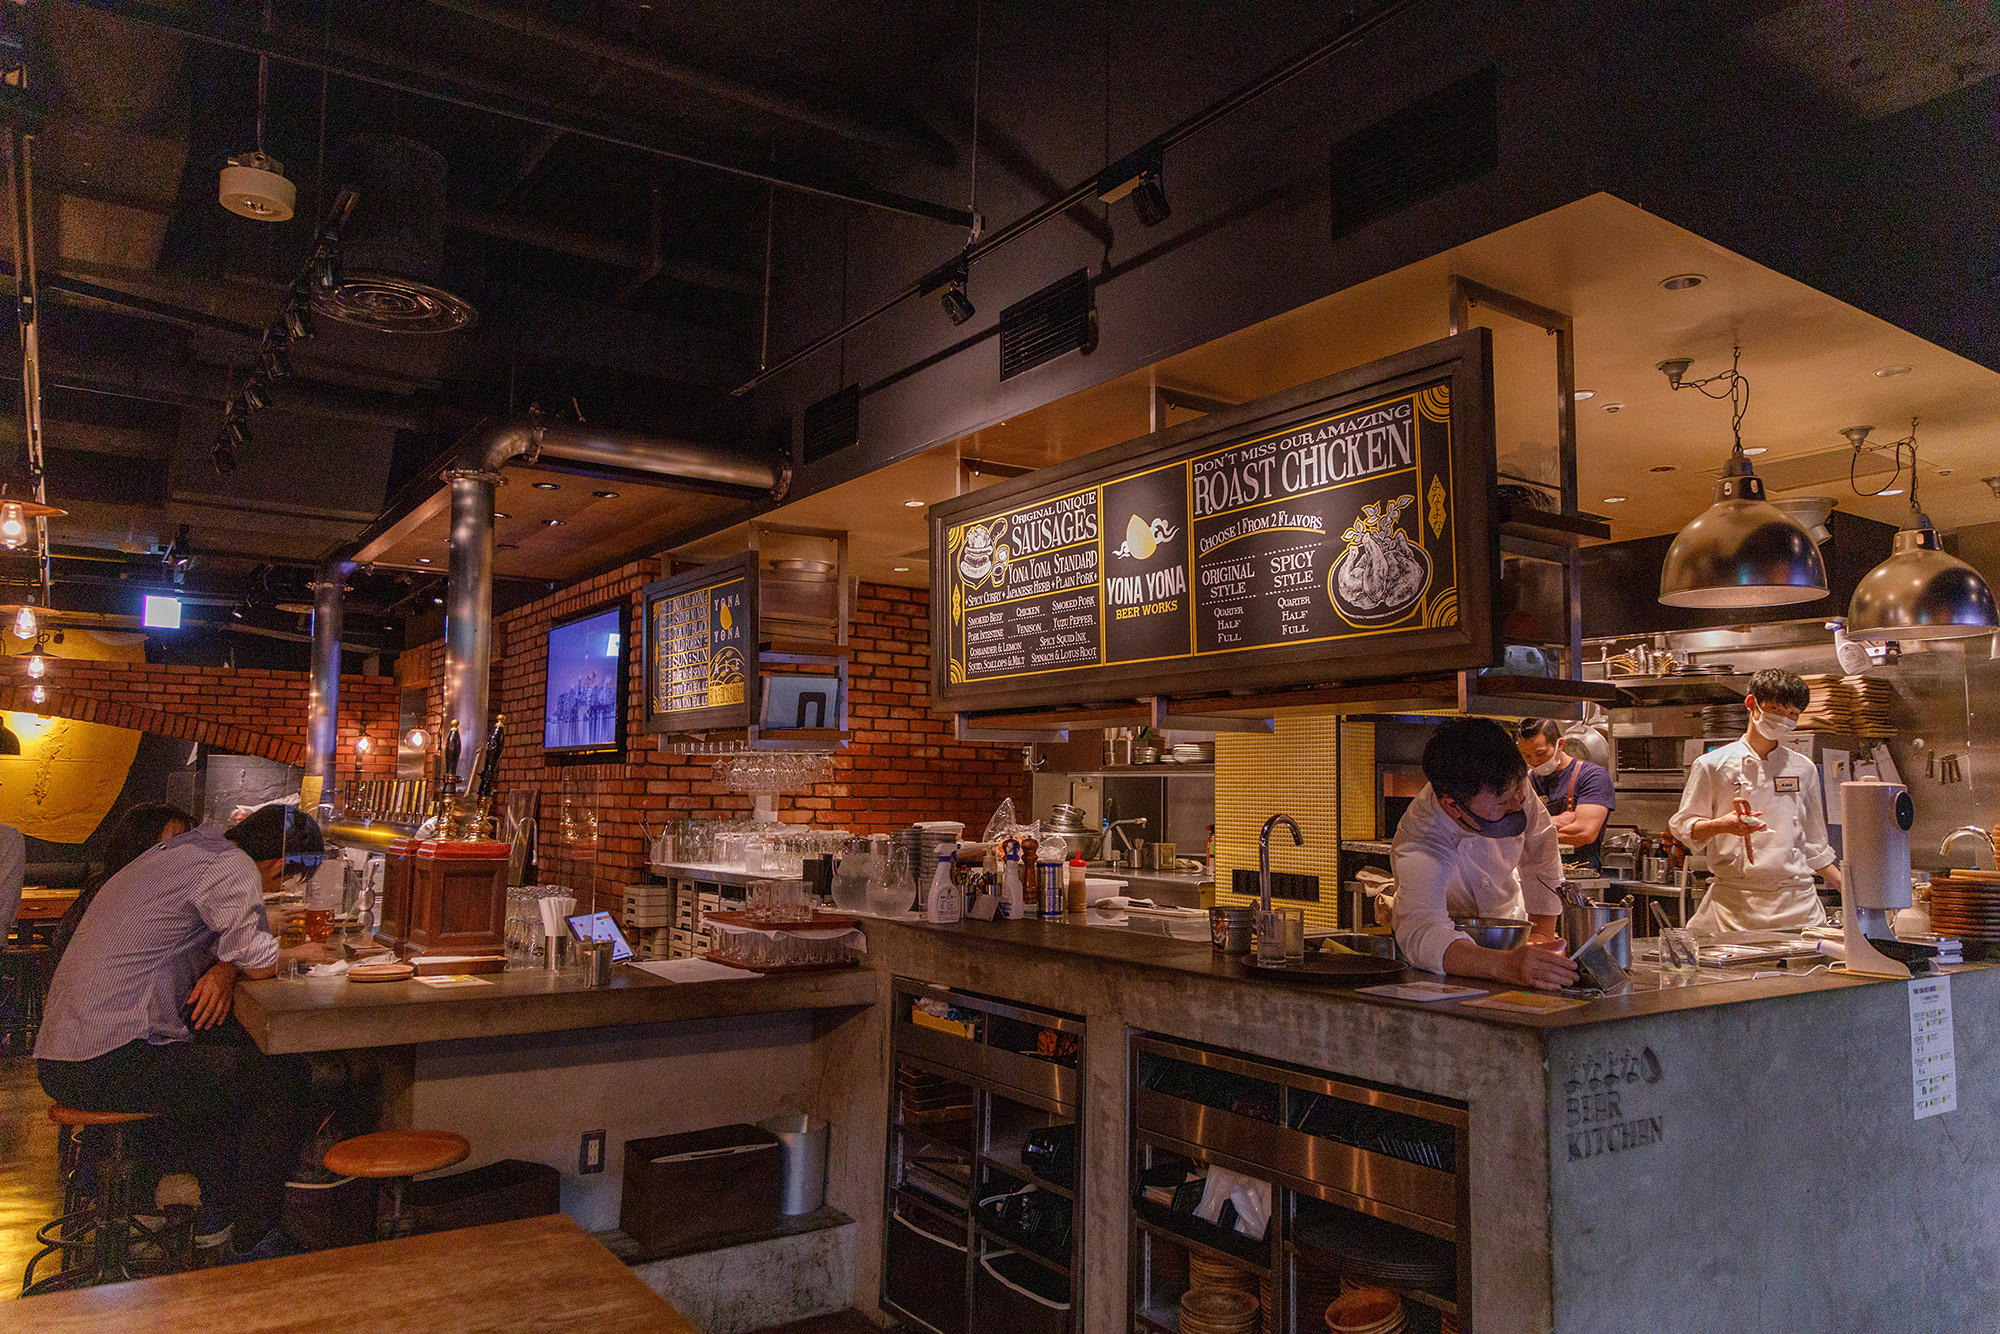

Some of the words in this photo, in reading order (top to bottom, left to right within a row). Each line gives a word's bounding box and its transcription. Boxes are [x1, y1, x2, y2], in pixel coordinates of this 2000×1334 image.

[1194, 453, 1238, 475] DON'T
[1241, 442, 1277, 460] MISS
[1280, 432, 1314, 451] OUR
[1315, 404, 1412, 442] AMAZING
[1194, 456, 1276, 516] ROAST
[1281, 419, 1413, 493] CHICKEN
[1012, 506, 1055, 525] ORIGINAL
[1056, 491, 1097, 513] UNIQUE
[1012, 508, 1097, 557] SAUSAGES
[1200, 523, 1237, 553] CHOOSE
[1242, 517, 1270, 532] FROM
[1271, 513, 1277, 528] 2
[1278, 510, 1323, 530] FLAVORS
[1008, 562, 1029, 585] YONA
[1029, 559, 1051, 580] YONA
[1054, 550, 1098, 575] STANDARD
[1270, 550, 1316, 574] SPICY
[1201, 562, 1255, 586] ORIGINAL
[1274, 570, 1314, 588] STYLE
[968, 595, 983, 607] SPICY
[1056, 577, 1076, 590] PLAIN
[1076, 572, 1095, 584] PORK
[1106, 575, 1143, 605] YONA
[1145, 565, 1187, 602] YONA
[1210, 582, 1246, 598] STYLE
[714, 594, 740, 611] YONA
[1052, 598, 1078, 611] SMOKED
[1078, 596, 1095, 606] PORK
[1116, 605, 1140, 620] BEER
[1141, 600, 1178, 616] WORKS
[1277, 596, 1311, 609] QUARTER
[1016, 606, 1040, 618] CHICKEN
[1069, 614, 1093, 626] PEPPER
[1213, 606, 1244, 618] QUARTER
[1281, 610, 1308, 621] HALF
[1016, 623, 1042, 634] VENISON
[1217, 620, 1241, 631] HALF
[1282, 624, 1309, 635] FULL
[714, 626, 740, 643] YONA
[1217, 632, 1242, 643] FULL
[1002, 641, 1023, 652] LEMON
[1566, 1091, 1622, 1128] BEER
[1567, 1116, 1663, 1162] KITCHEN
